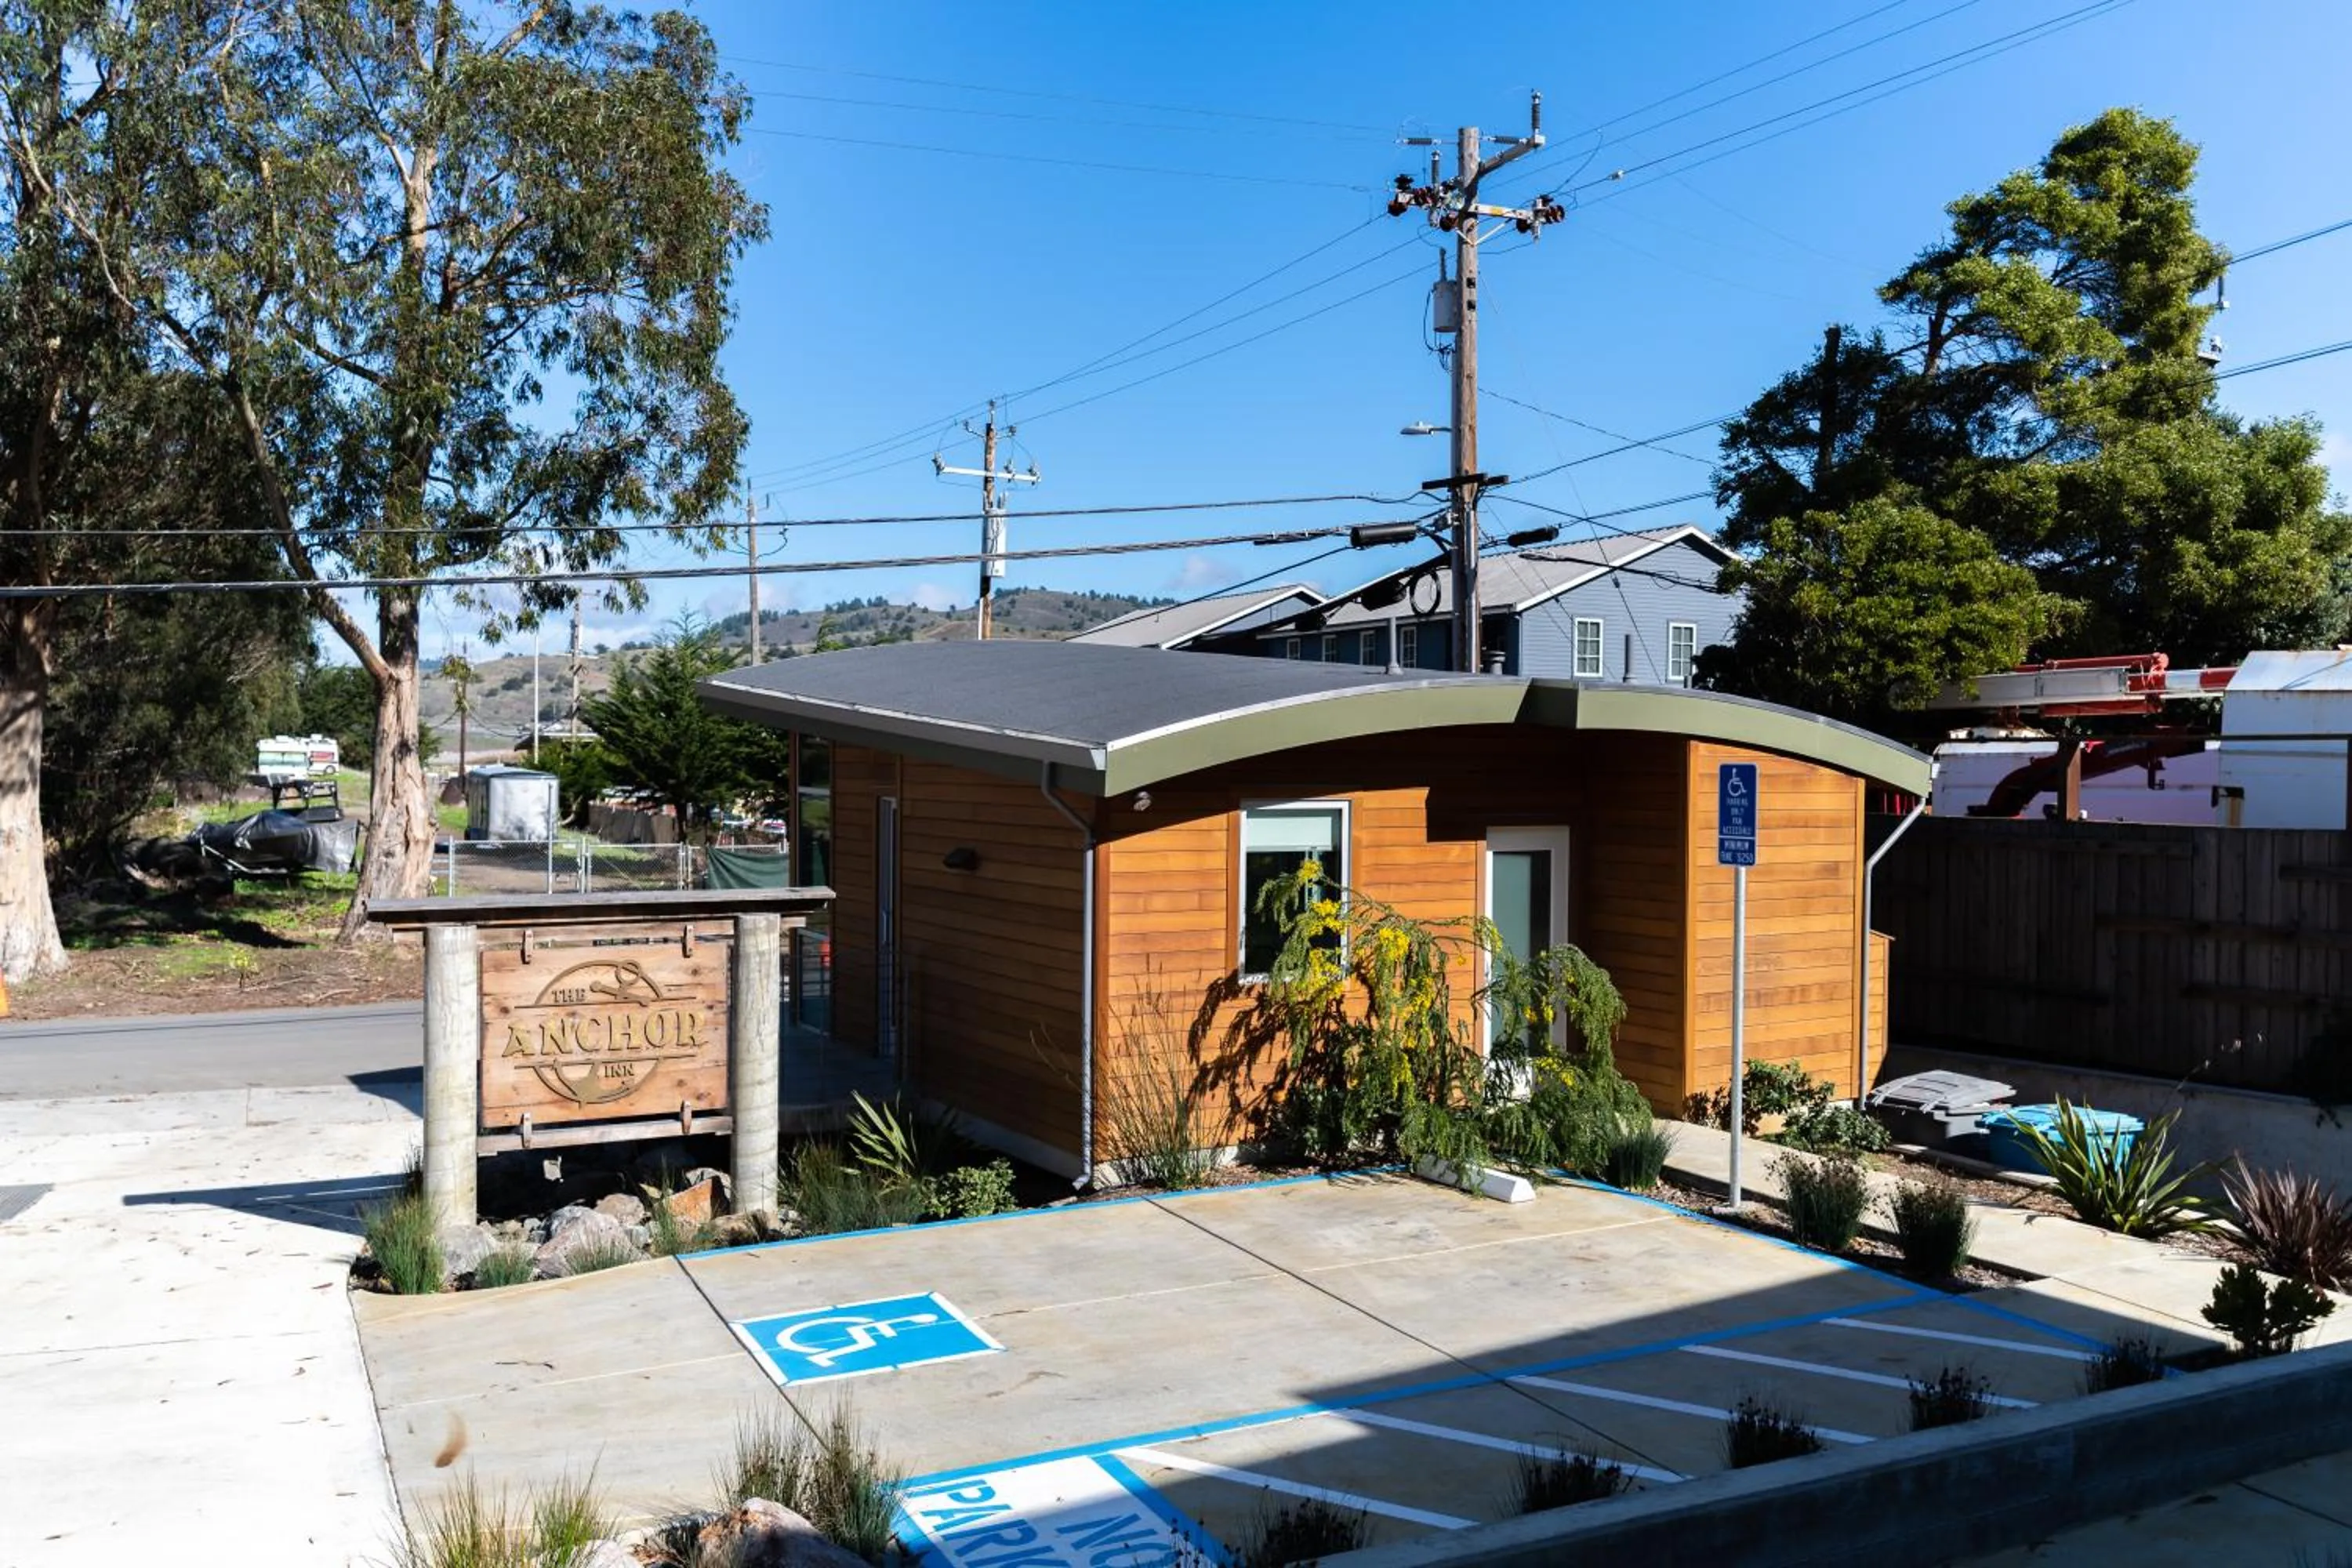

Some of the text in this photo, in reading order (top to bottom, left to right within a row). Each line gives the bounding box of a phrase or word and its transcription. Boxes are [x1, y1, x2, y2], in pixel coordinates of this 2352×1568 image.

[551, 988, 586, 1003] THE
[501, 1011, 708, 1058] ANCHOR
[604, 1063, 635, 1079] INN
